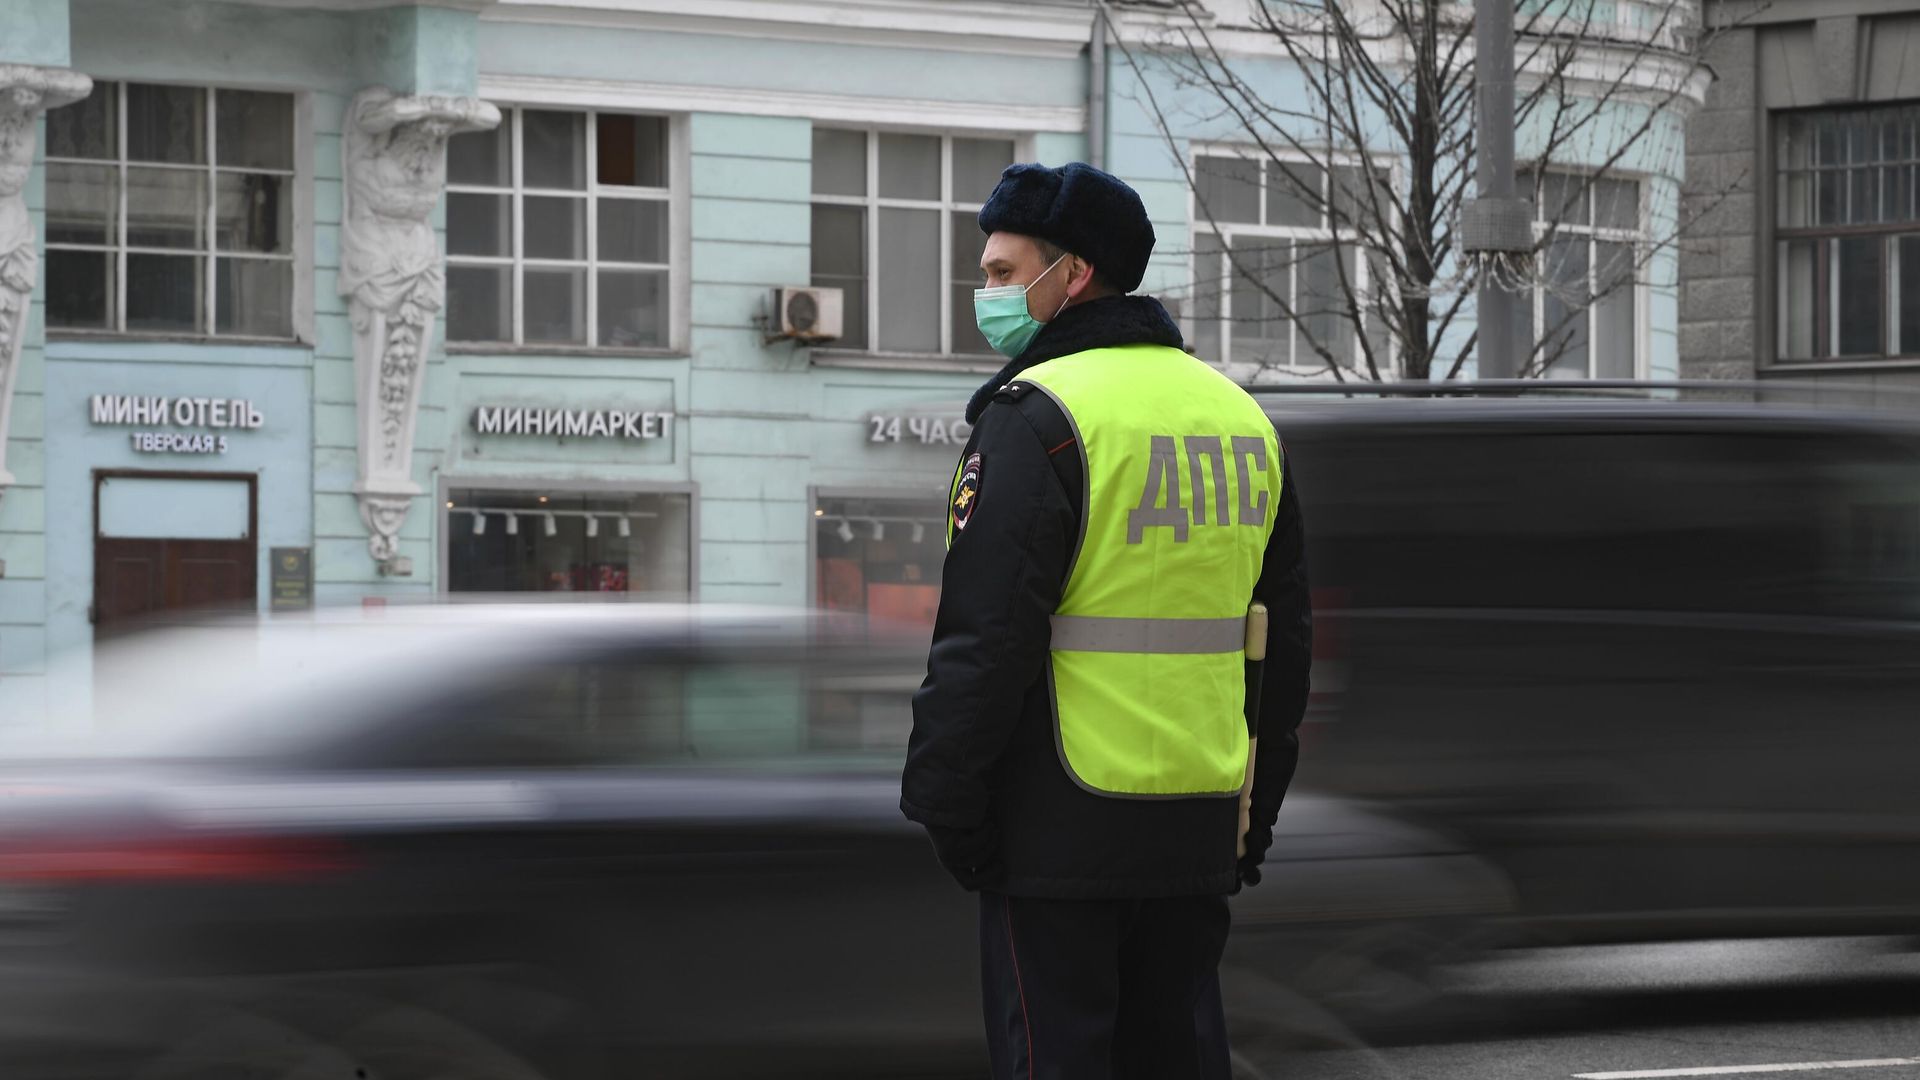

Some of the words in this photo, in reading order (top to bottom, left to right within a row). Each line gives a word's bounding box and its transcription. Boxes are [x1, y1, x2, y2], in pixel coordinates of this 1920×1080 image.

[92, 395, 168, 424] МИНИ
[174, 397, 264, 428] ОТЕЛЬ
[477, 406, 673, 438] МИНИМАРКЕТ
[133, 432, 215, 453] ТВЕРСКАЯ
[218, 435, 228, 454] 5
[870, 415, 901, 442] 24
[1127, 436, 1269, 544] ДПС
